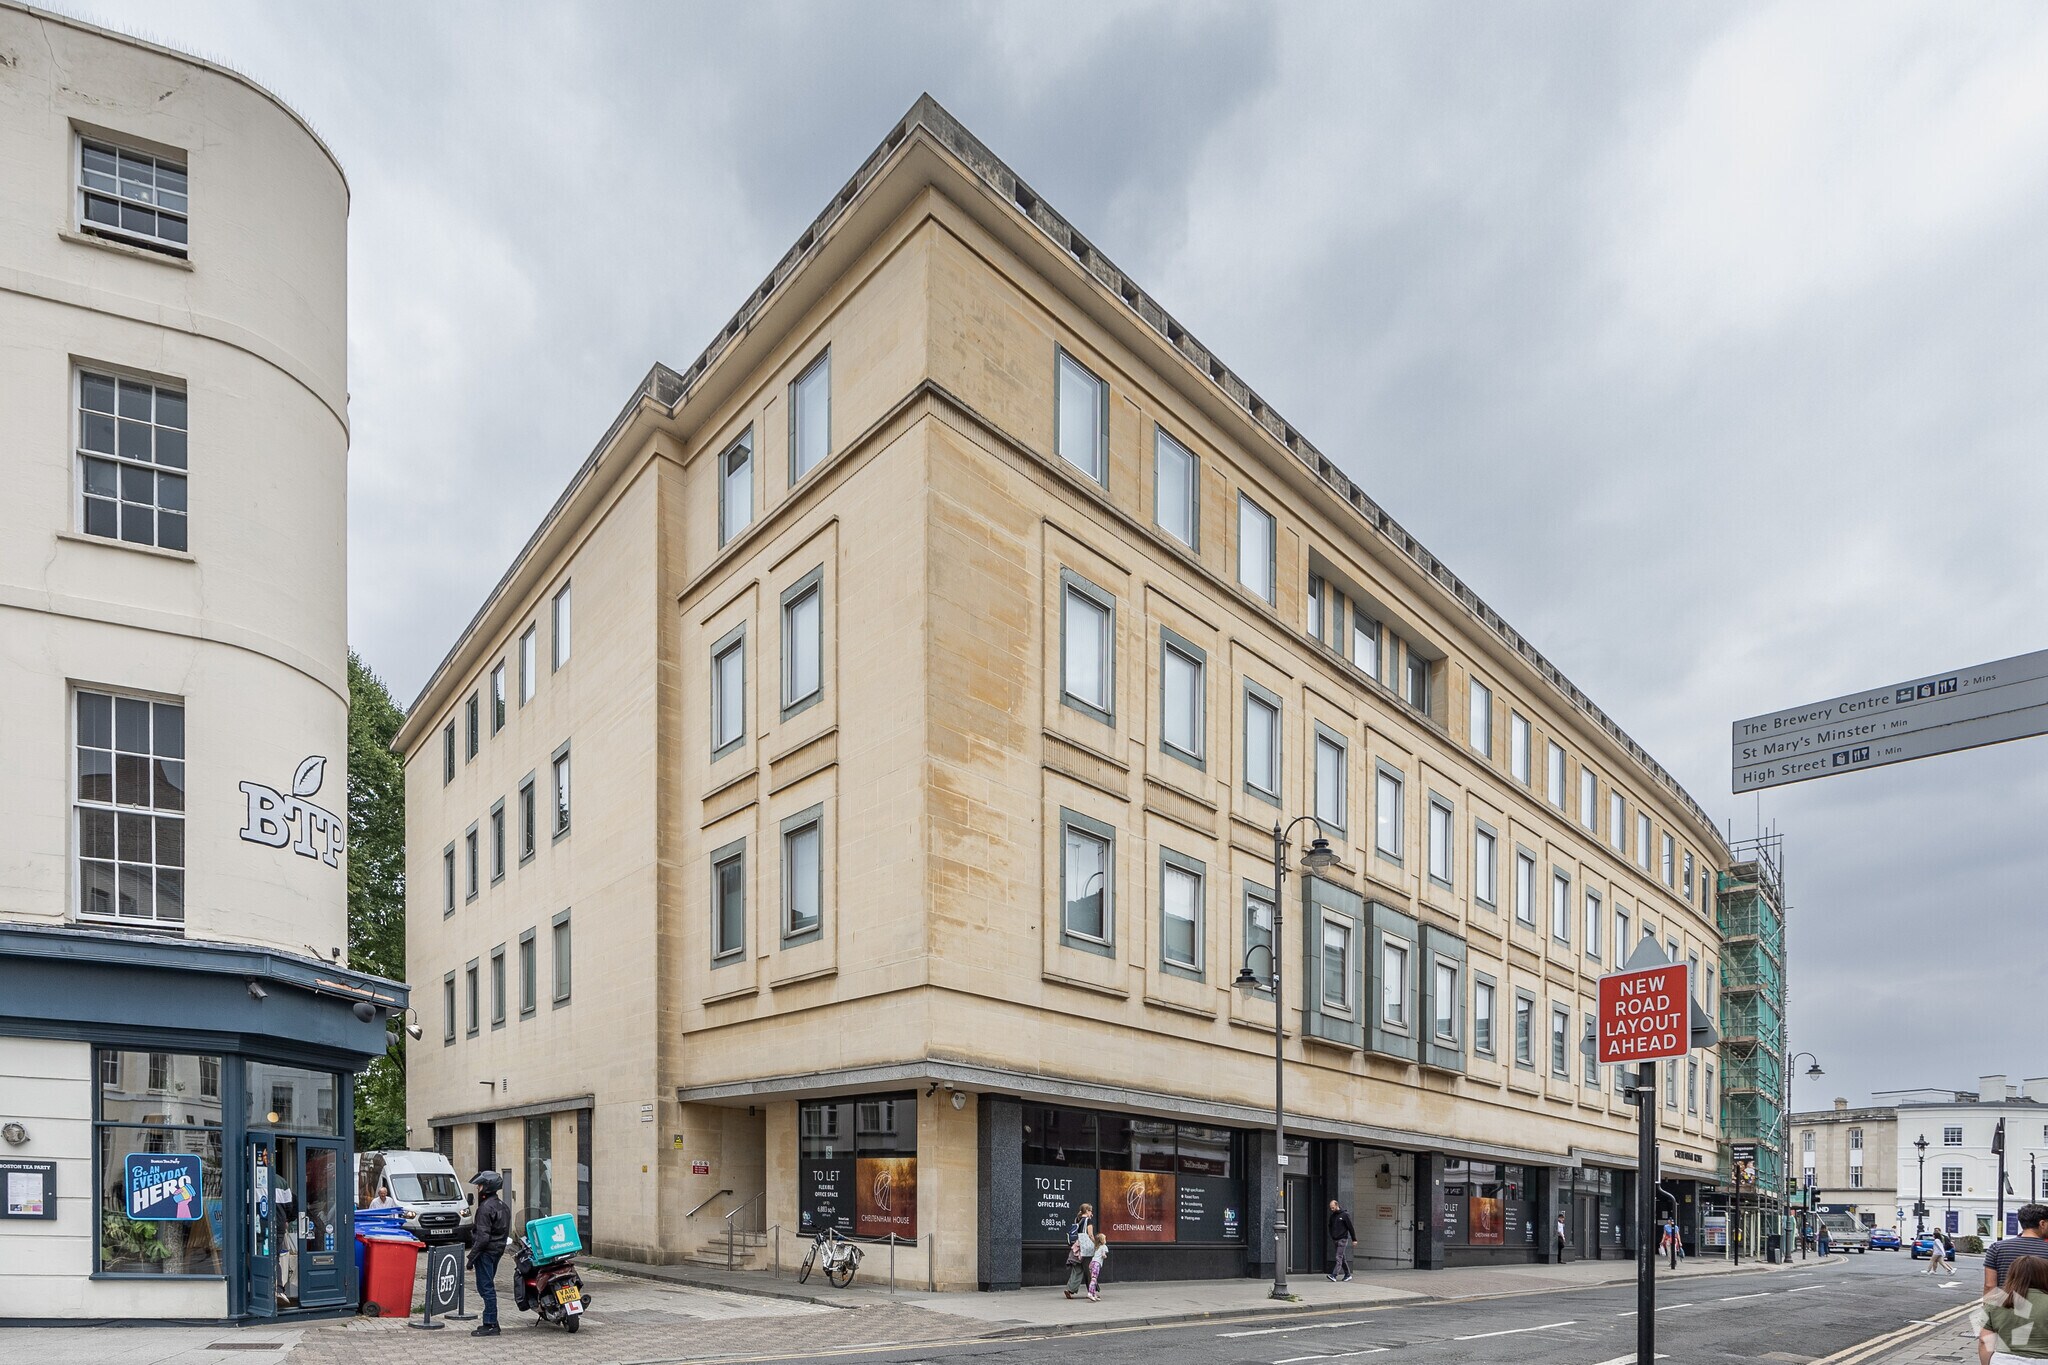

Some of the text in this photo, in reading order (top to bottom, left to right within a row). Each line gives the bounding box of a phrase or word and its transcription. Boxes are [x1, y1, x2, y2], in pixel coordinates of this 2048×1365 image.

[1743, 722, 1768, 736] The
[1774, 708, 1832, 729] Brewery
[1839, 694, 1890, 714] Centre
[1974, 674, 1996, 684] Mins
[1742, 748, 1757, 760] St
[1764, 737, 1810, 756] Mary's
[1817, 722, 1876, 744] Minster
[1890, 720, 1908, 729] Min
[1743, 767, 1775, 784] High
[1782, 757, 1826, 776] Street
[1885, 746, 1902, 756] Min
[239, 780, 345, 869] BTP
[1620, 975, 1666, 996] NEW
[1615, 995, 1670, 1016] ROAD
[1606, 1013, 1681, 1037] LAYOUT
[1608, 1034, 1677, 1055] AHEAD
[132, 1166, 160, 1177] Be AN
[133, 1166, 188, 1191] EVERYDAY
[813, 1170, 840, 1181] TO LET
[1035, 1177, 1072, 1190] TO LET
[133, 1175, 191, 1214] HERO
[861, 1214, 910, 1224] CHELTENHAM HOUSE
[440, 1272, 454, 1293] BTP
[568, 1302, 578, 1311] L
